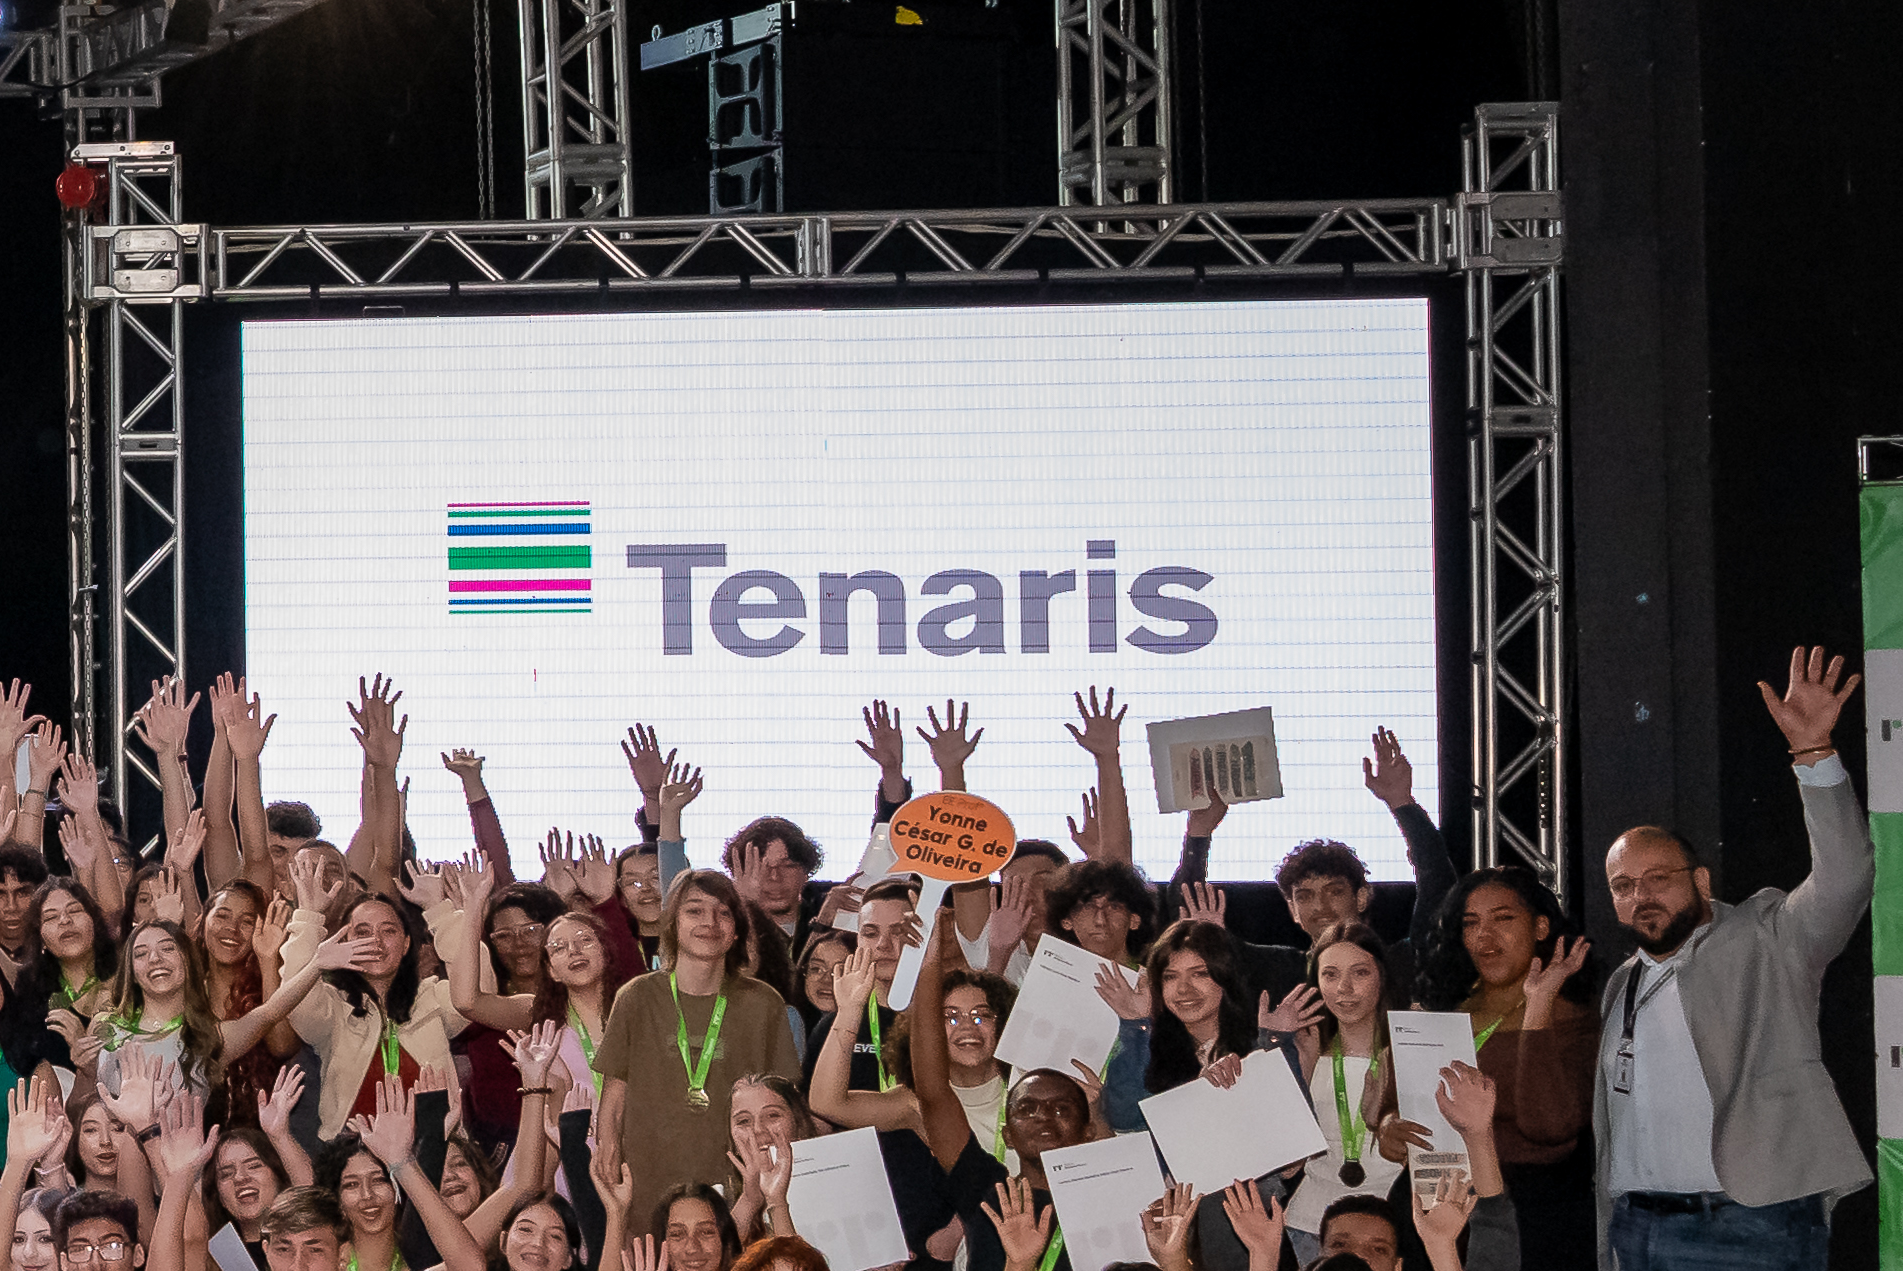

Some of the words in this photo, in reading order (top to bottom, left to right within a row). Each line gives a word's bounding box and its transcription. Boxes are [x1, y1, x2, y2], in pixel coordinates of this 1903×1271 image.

[626, 540, 1219, 658] Tenaris
[929, 805, 988, 832] Yonne
[894, 820, 953, 846] César
[957, 834, 975, 852] G.
[982, 840, 1008, 858] de
[906, 844, 982, 874] Oliveira
